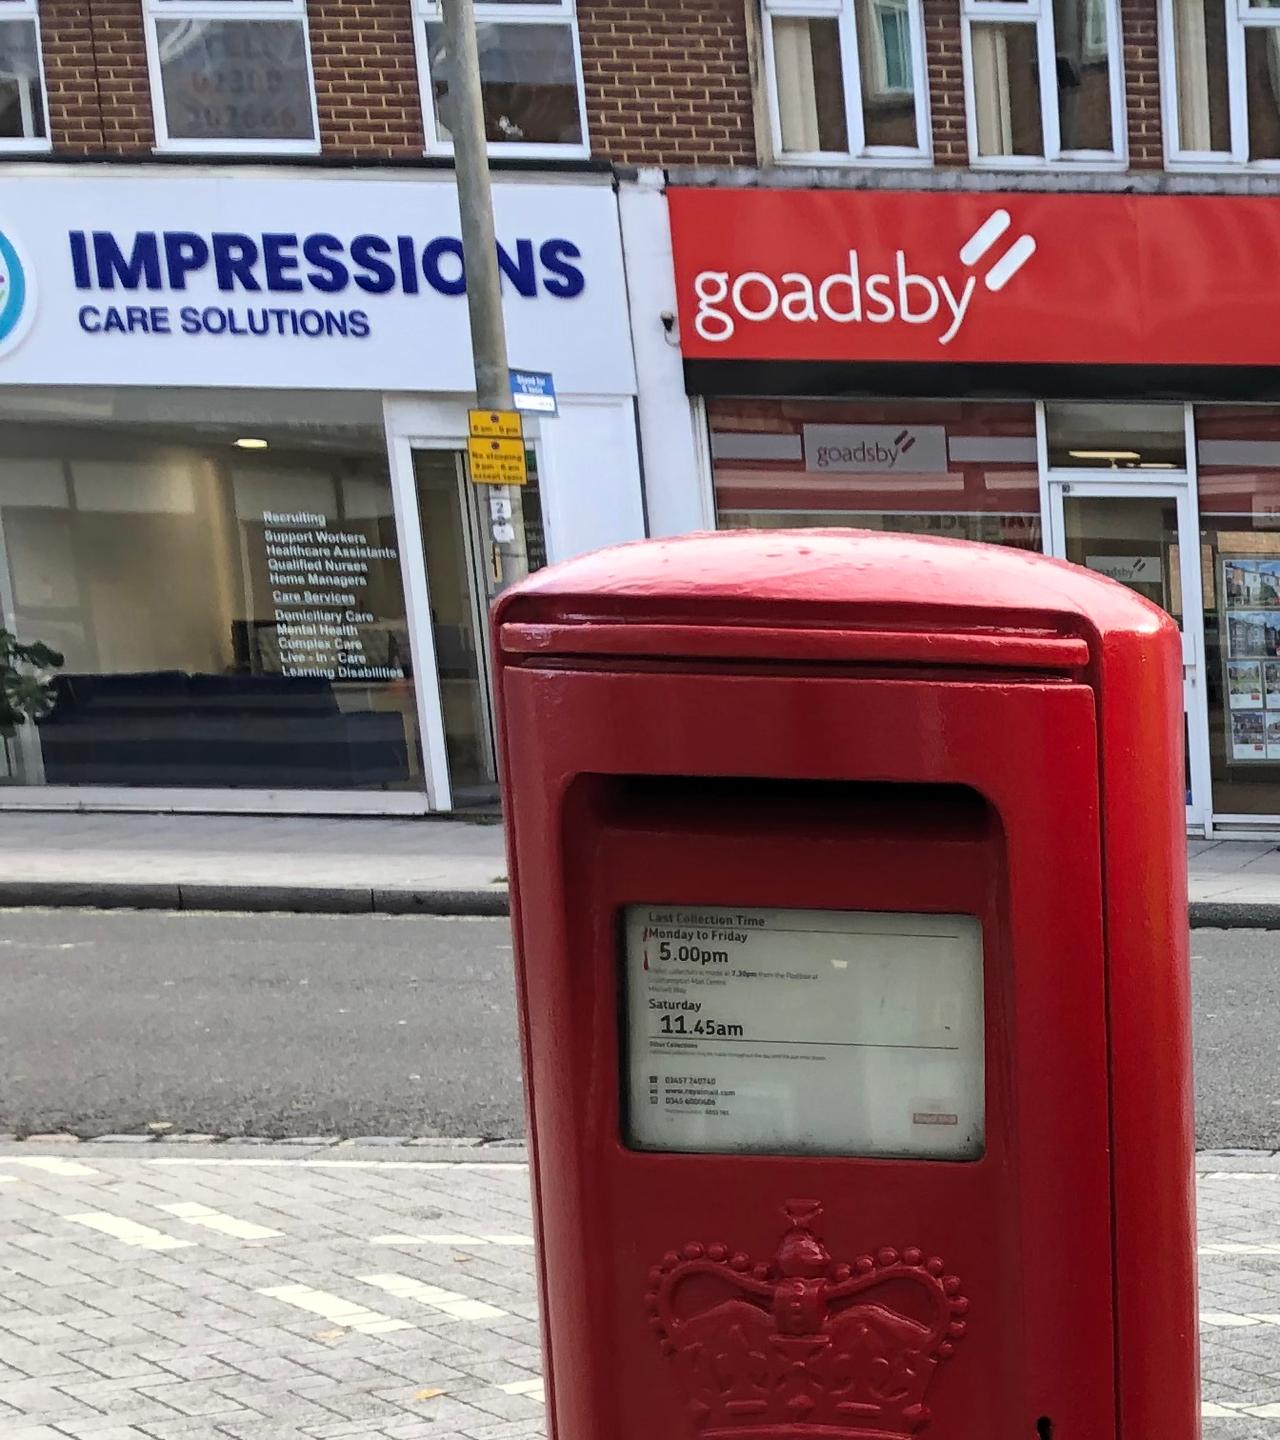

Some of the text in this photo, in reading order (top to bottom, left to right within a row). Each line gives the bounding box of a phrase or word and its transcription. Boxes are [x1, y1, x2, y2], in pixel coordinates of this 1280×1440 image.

[68, 230, 586, 298] IMPRESSIONS
[693, 250, 976, 344] goadsby
[78, 304, 371, 338] CARE SOLUTIONS
[816, 440, 899, 467] goadsby
[263, 511, 327, 527] Recruiting
[264, 530, 366, 544] Support Workers
[266, 545, 397, 559] Healthcare Assistants
[268, 558, 368, 571] Qualified Nurses
[269, 572, 368, 588] Home Managers
[273, 590, 356, 605] Care Services
[274, 609, 374, 624] Domiciliary Care
[276, 624, 358, 636] Mental Health
[278, 637, 363, 651] Complex Care
[280, 651, 306, 662] Live
[316, 652, 328, 662] In
[338, 652, 367, 664] Care
[282, 665, 404, 679] Learning Disabilities
[649, 912, 765, 926] Last Collection Time
[649, 928, 748, 943] Monday to Friday
[659, 941, 729, 965] 5.00pm
[649, 998, 702, 1012] Saturday
[660, 1014, 743, 1036] 11.45am
